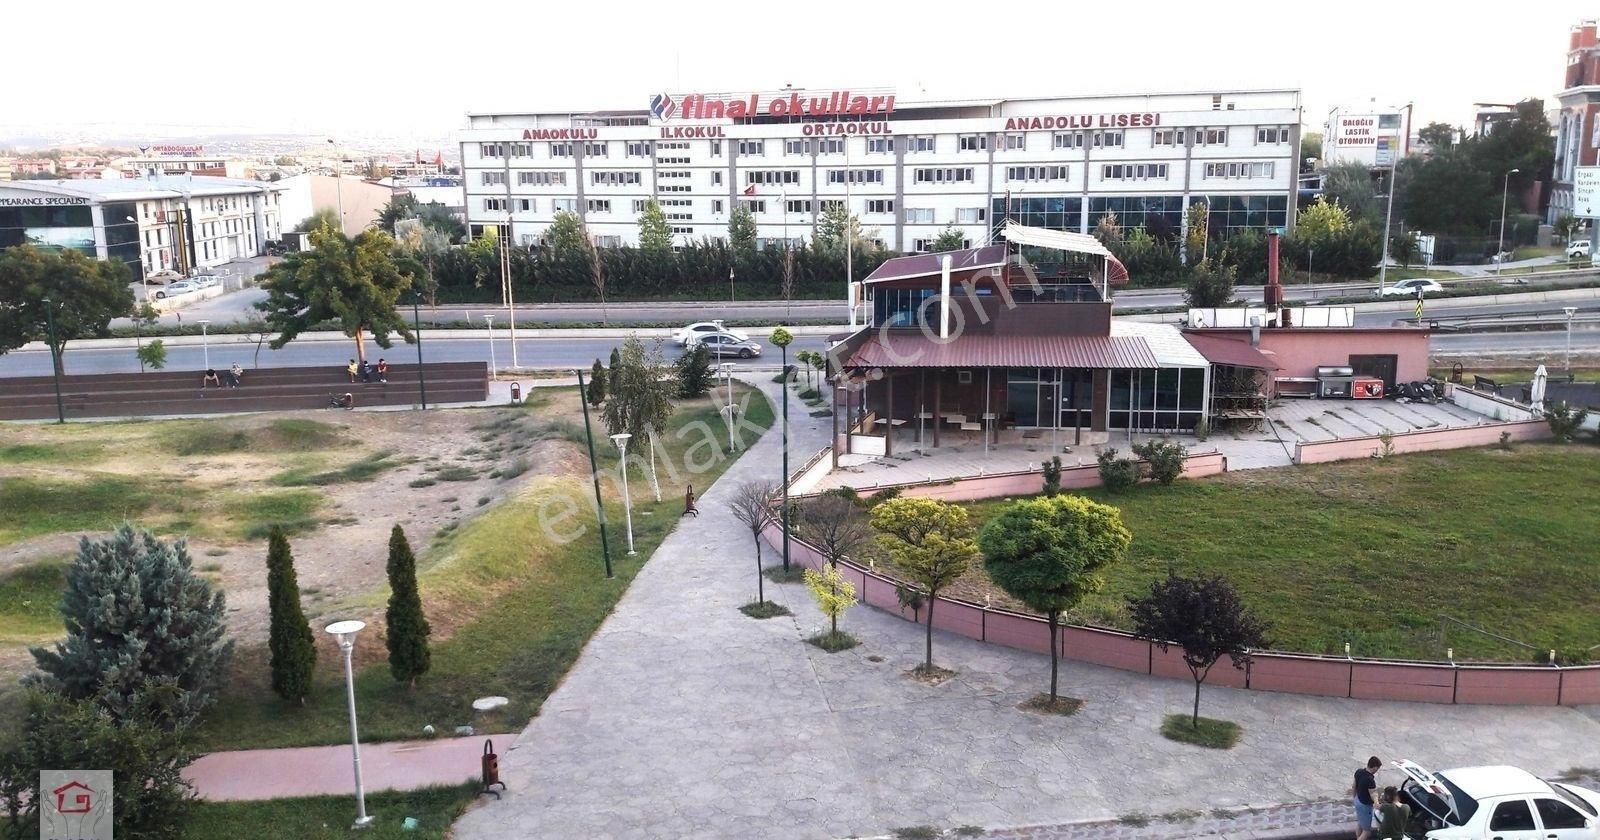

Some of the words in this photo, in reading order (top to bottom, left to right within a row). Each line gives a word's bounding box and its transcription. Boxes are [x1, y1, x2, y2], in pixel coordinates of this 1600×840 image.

[682, 93, 760, 119] final
[768, 91, 895, 116] okulları
[1005, 115, 1093, 130] ANADOLU
[1343, 118, 1373, 126] BALOĞLU
[523, 128, 598, 140] ANAOKULU
[802, 122, 892, 136] ORTAOKUL
[1338, 137, 1375, 145] OTOMOTİV
[45, 197, 88, 205] SPECIALIST
